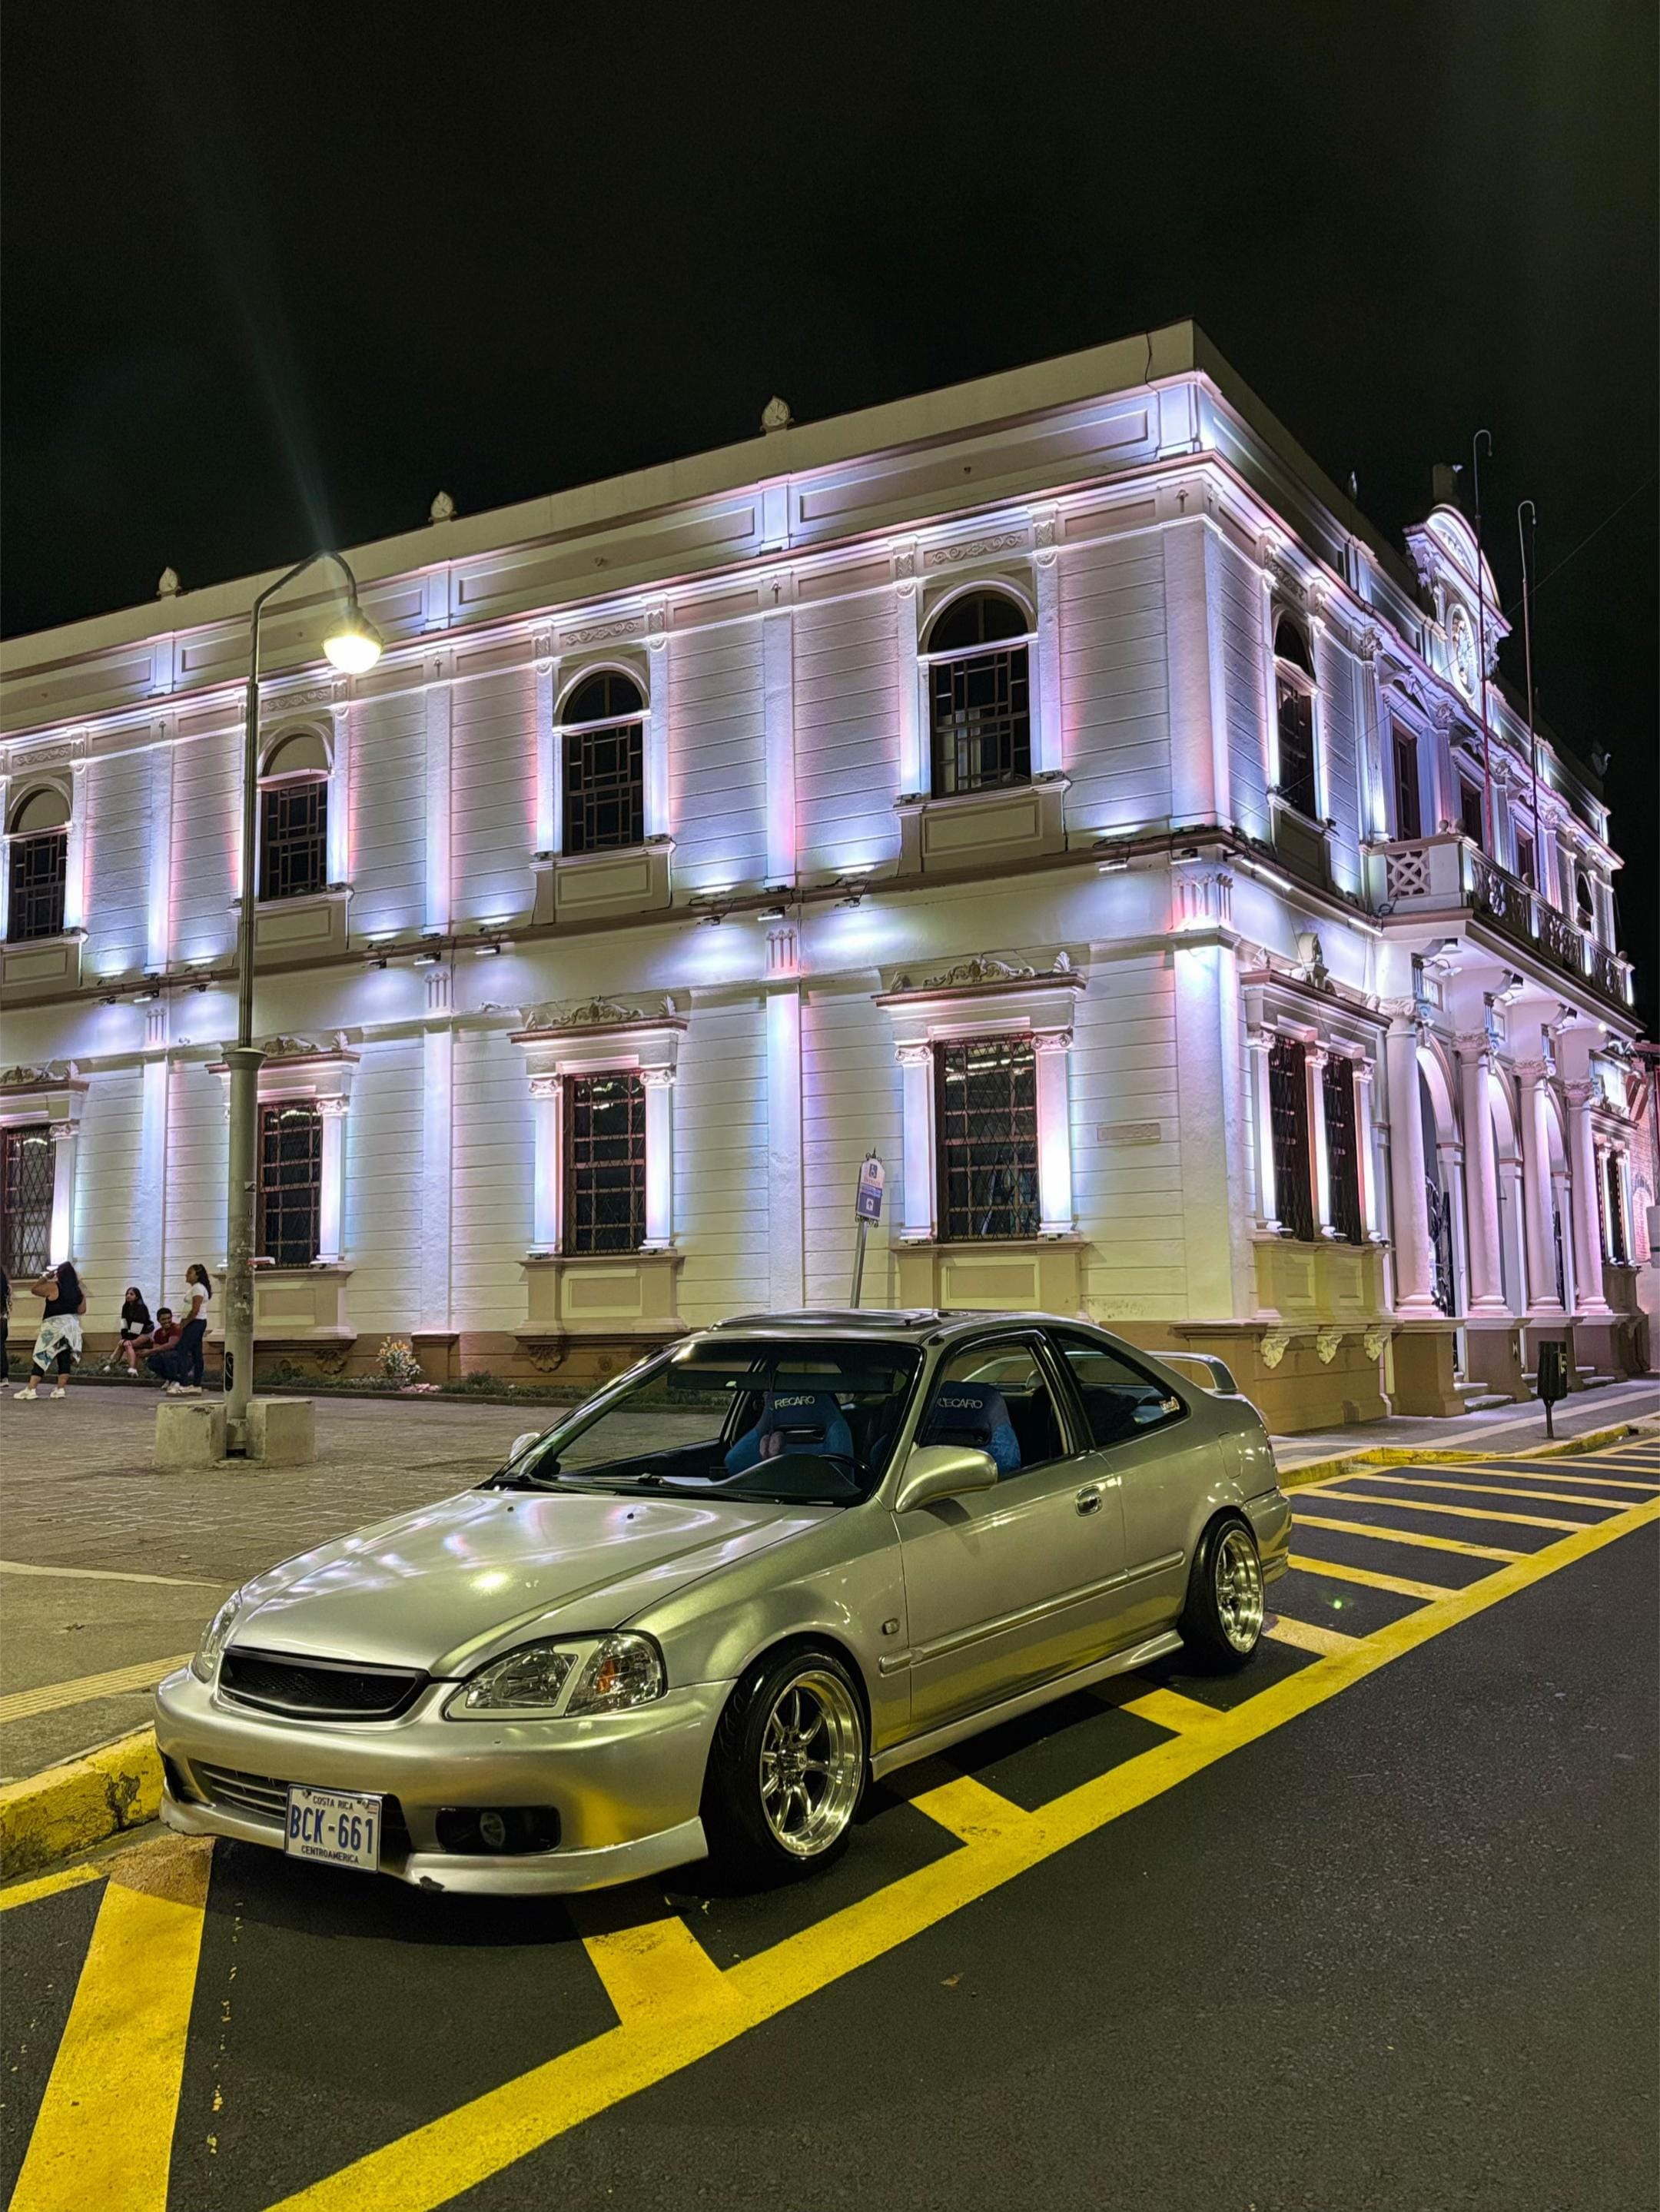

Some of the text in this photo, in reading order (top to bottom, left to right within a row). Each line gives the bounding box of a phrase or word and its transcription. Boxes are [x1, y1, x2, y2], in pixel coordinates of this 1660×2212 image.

[774, 1395, 815, 1410] RECARO
[313, 1795, 354, 1811] COSTA RICA
[289, 1804, 374, 1854] BCK-661
[300, 1845, 360, 1865] CENTROAMERICA
